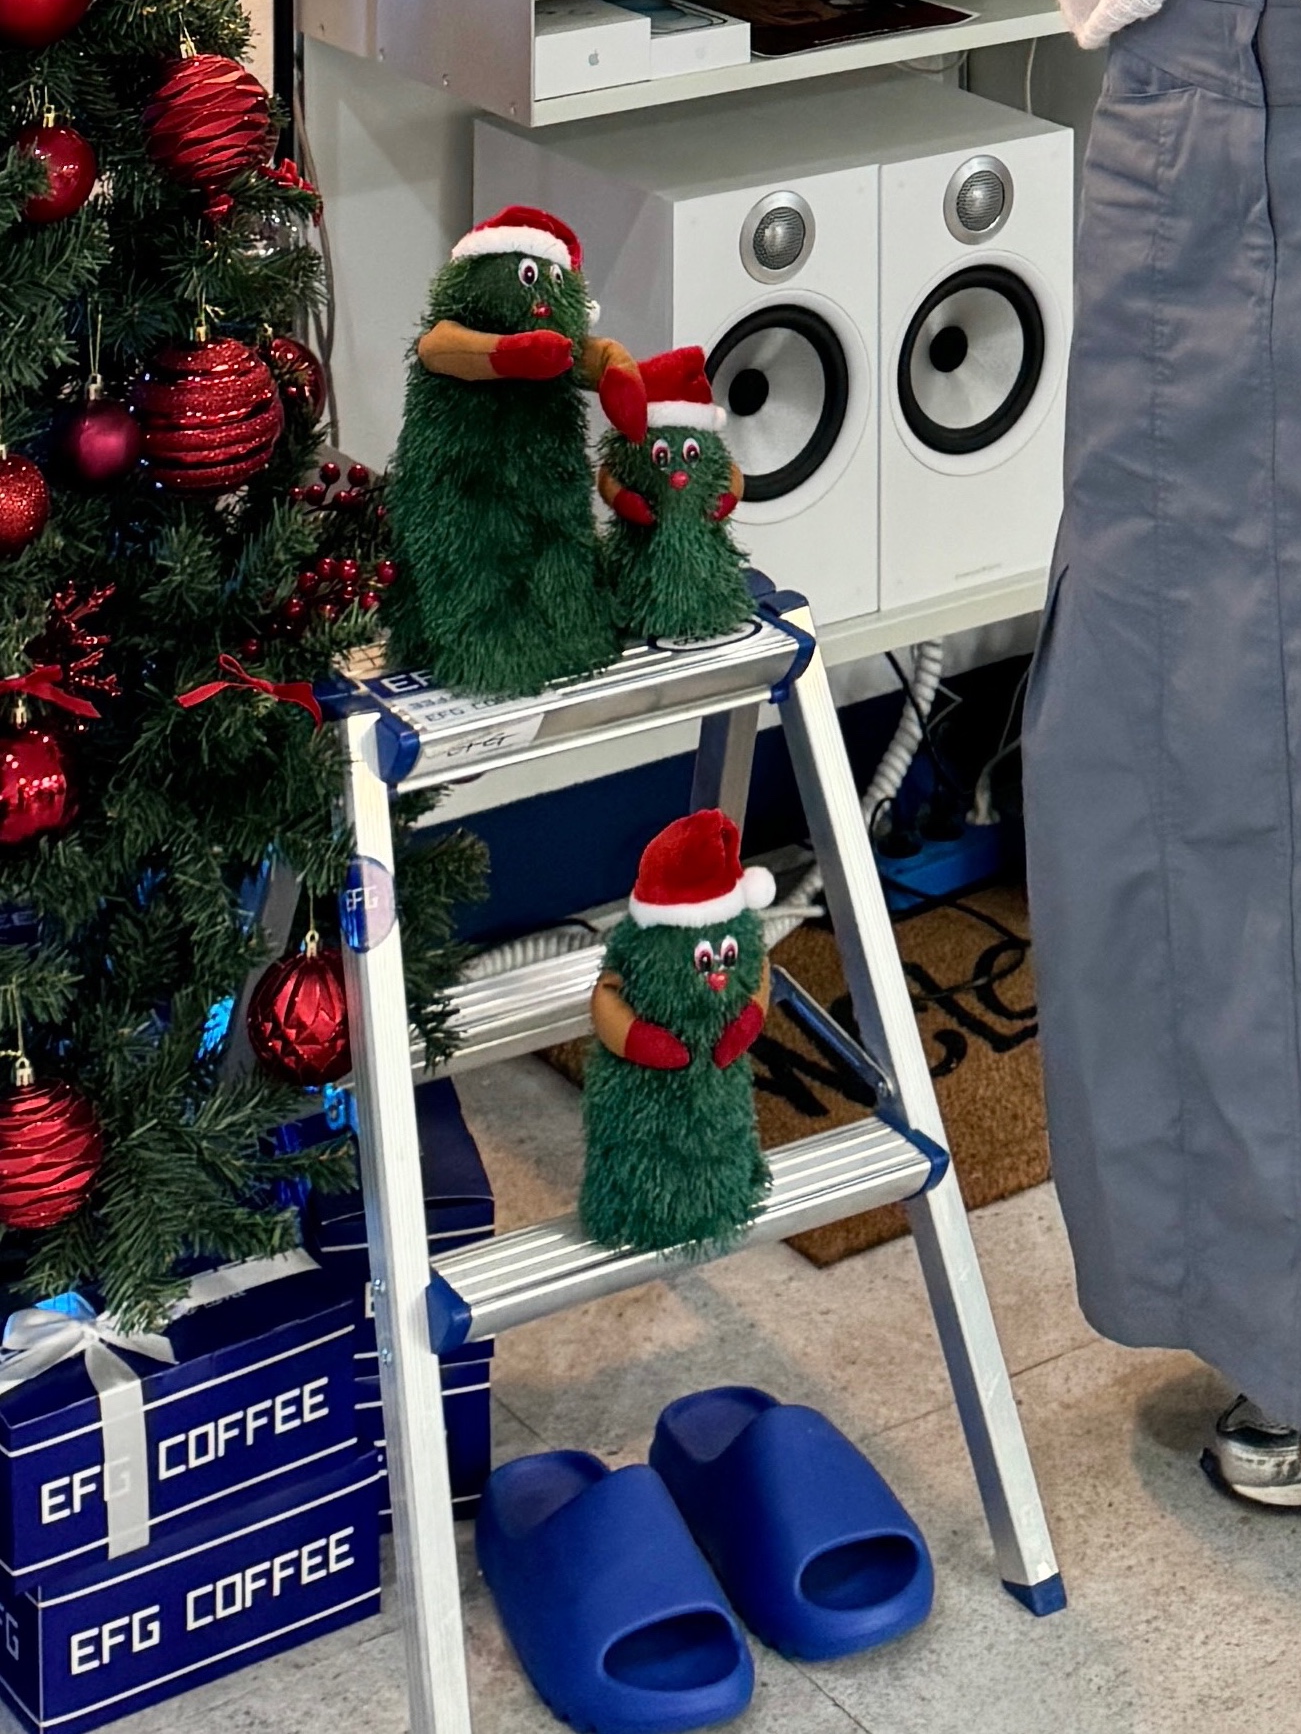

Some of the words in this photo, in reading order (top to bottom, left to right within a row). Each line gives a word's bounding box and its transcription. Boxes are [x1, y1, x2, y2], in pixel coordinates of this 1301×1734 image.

[158, 1376, 329, 1481] COFFEE
[70, 1604, 160, 1675] EFG
[186, 1526, 354, 1631] COFFEE
